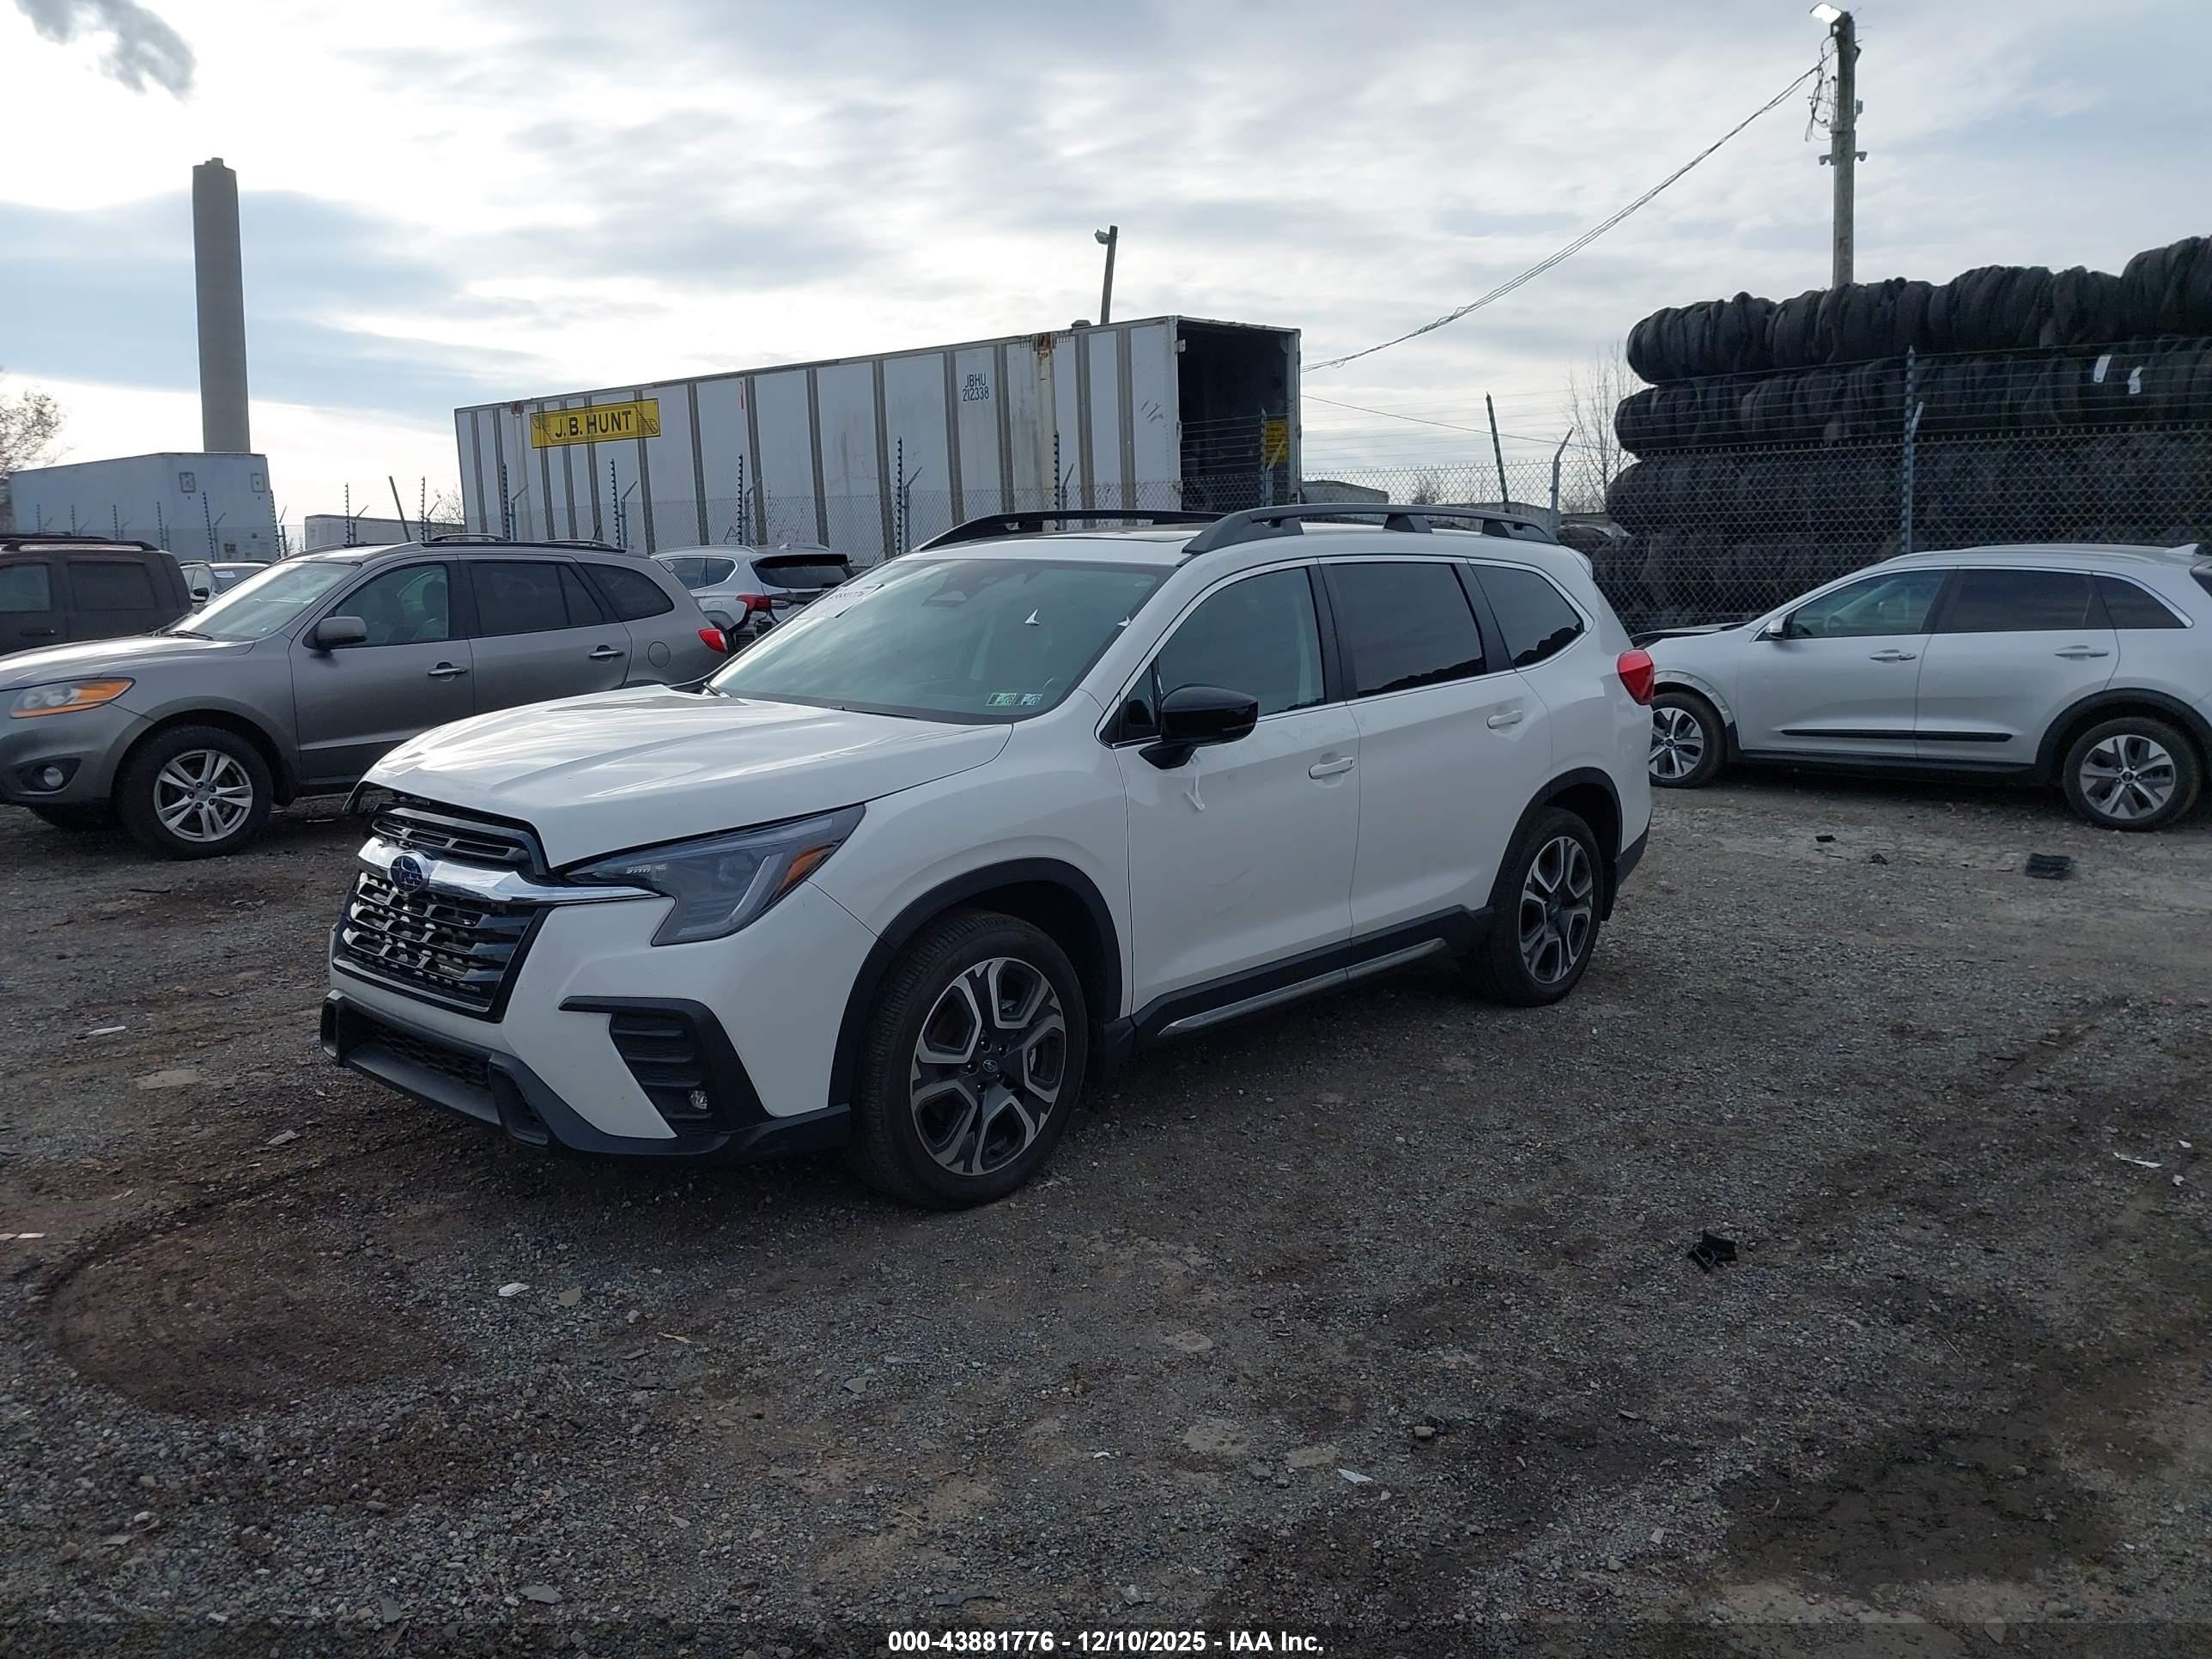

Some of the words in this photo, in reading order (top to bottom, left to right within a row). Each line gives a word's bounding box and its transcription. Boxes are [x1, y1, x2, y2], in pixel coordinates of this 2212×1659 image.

[965, 373, 986, 387] JBHU
[963, 386, 989, 402] 212338
[586, 410, 631, 434] HUNT
